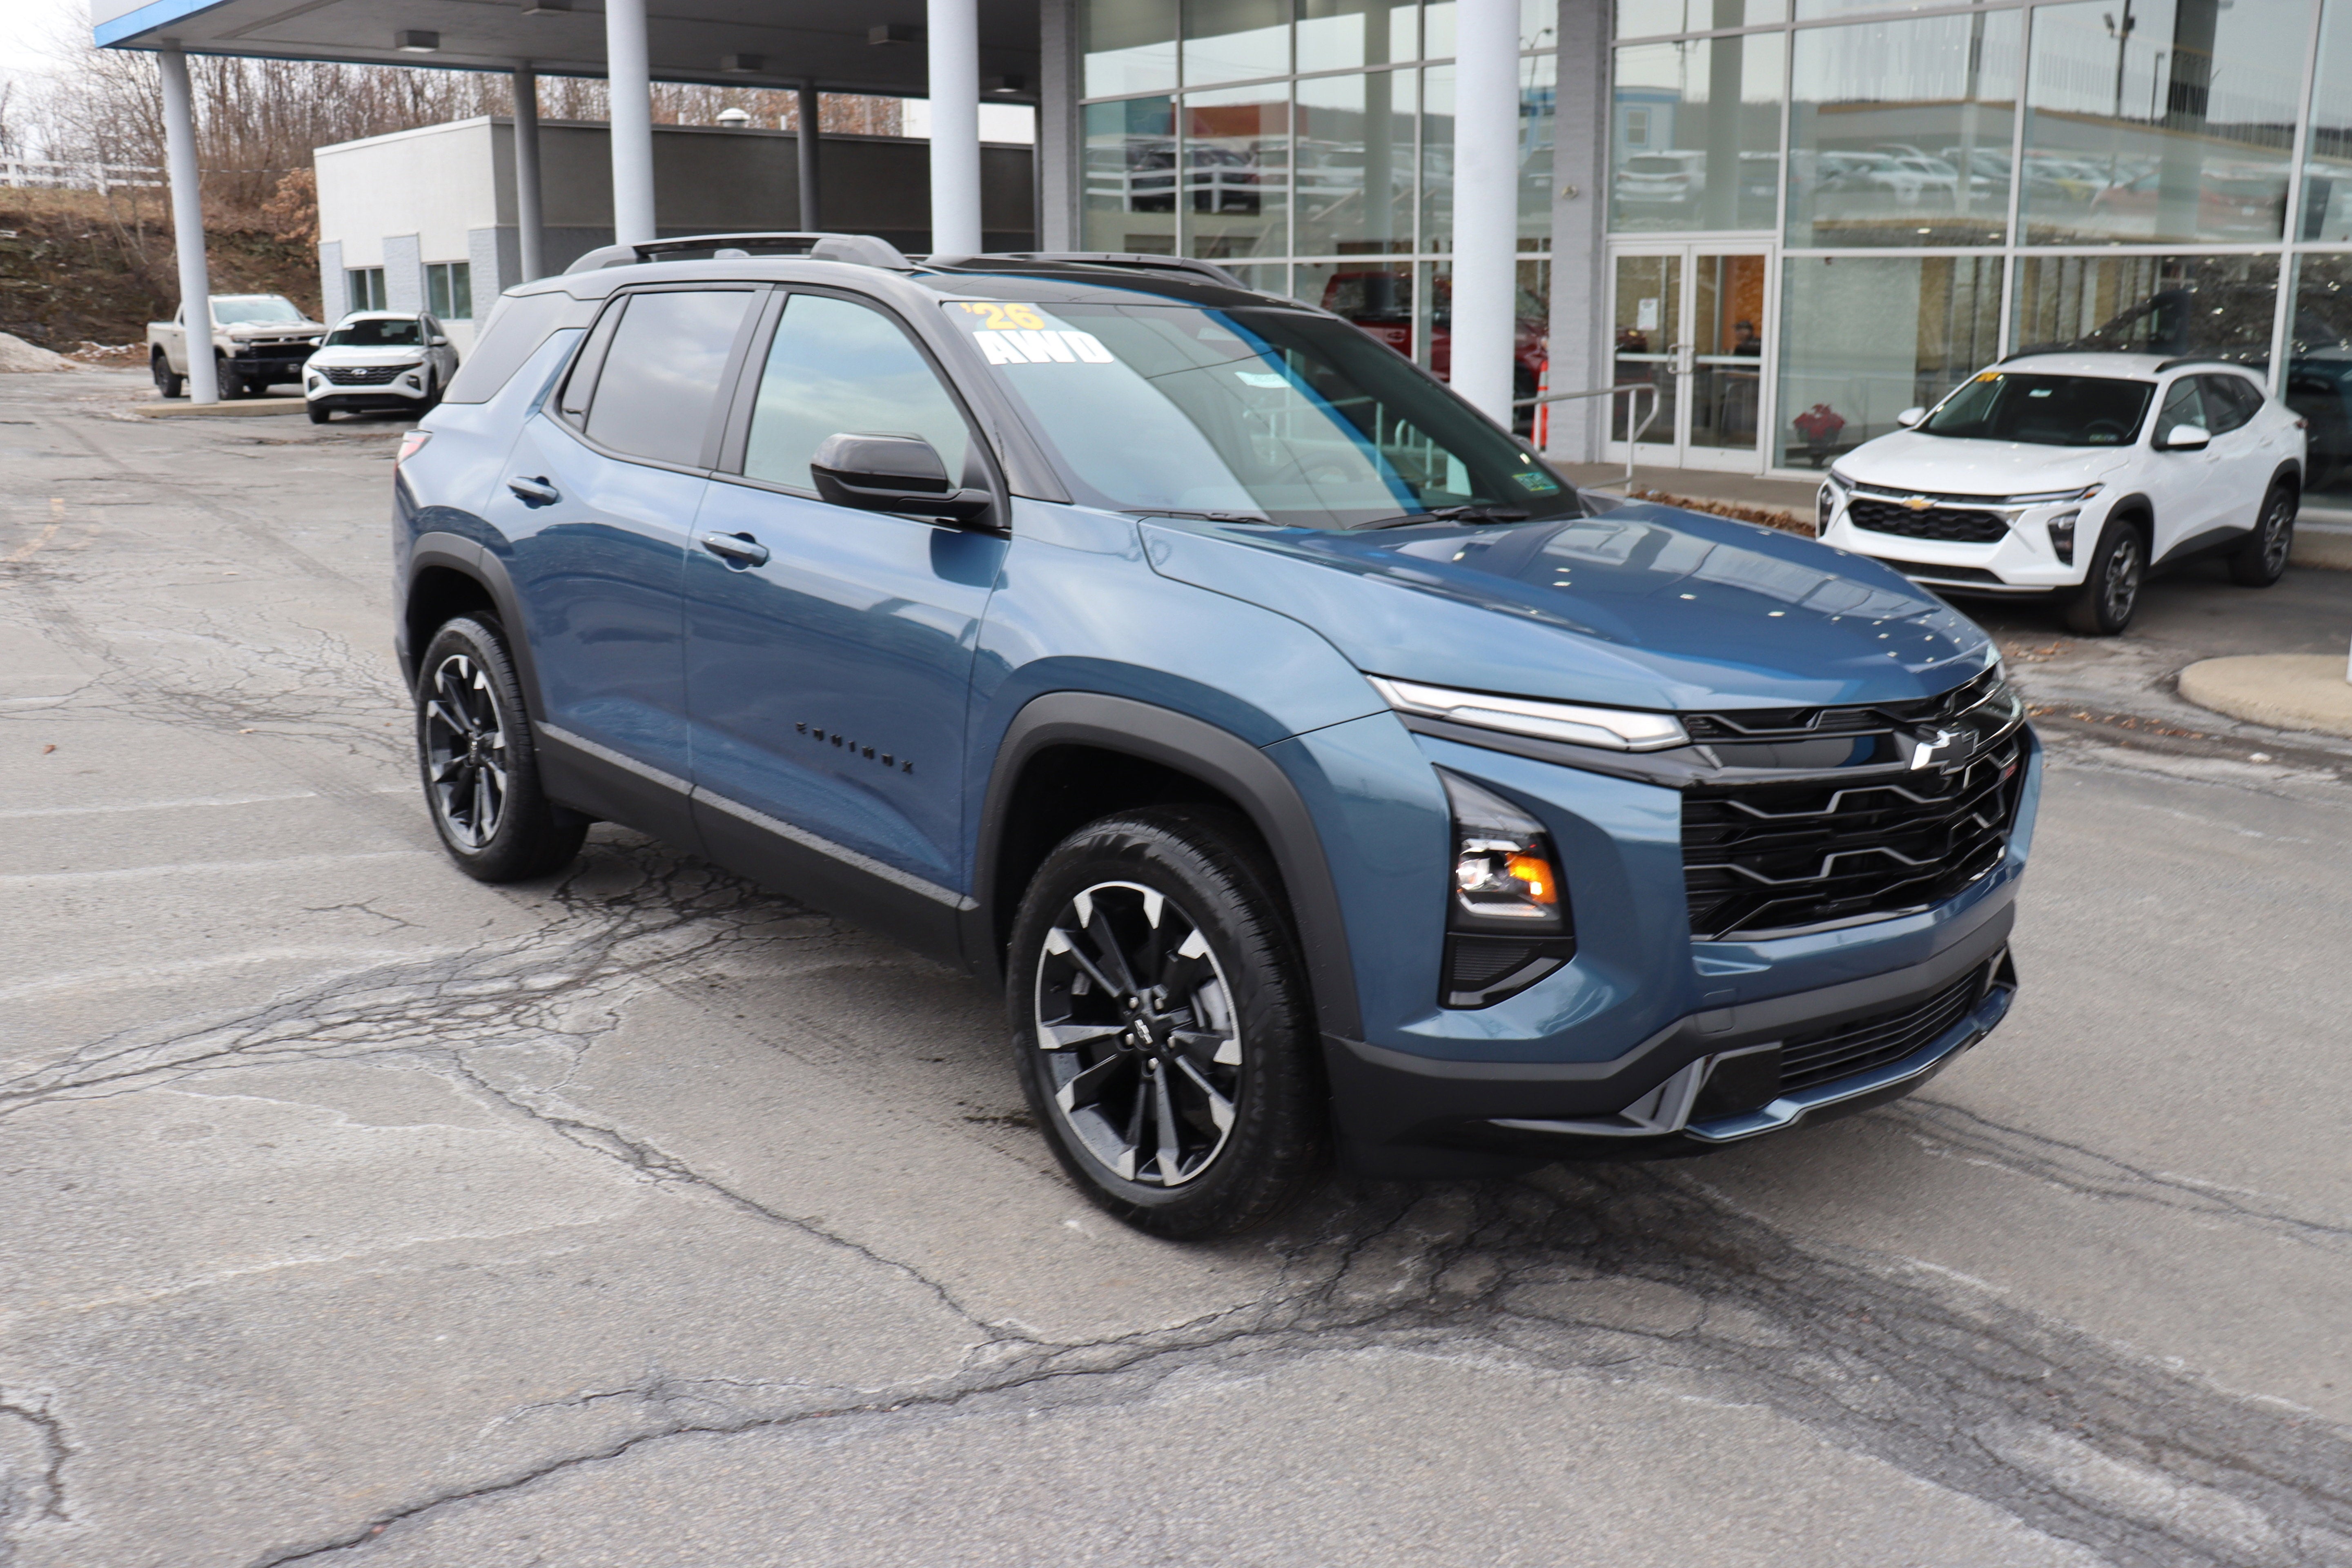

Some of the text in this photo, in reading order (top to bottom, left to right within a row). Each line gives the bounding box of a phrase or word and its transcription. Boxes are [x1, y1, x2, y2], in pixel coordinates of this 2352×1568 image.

[959, 302, 1045, 330] '26
[972, 330, 1114, 365] AWD
[796, 722, 913, 775] EQUINOX
